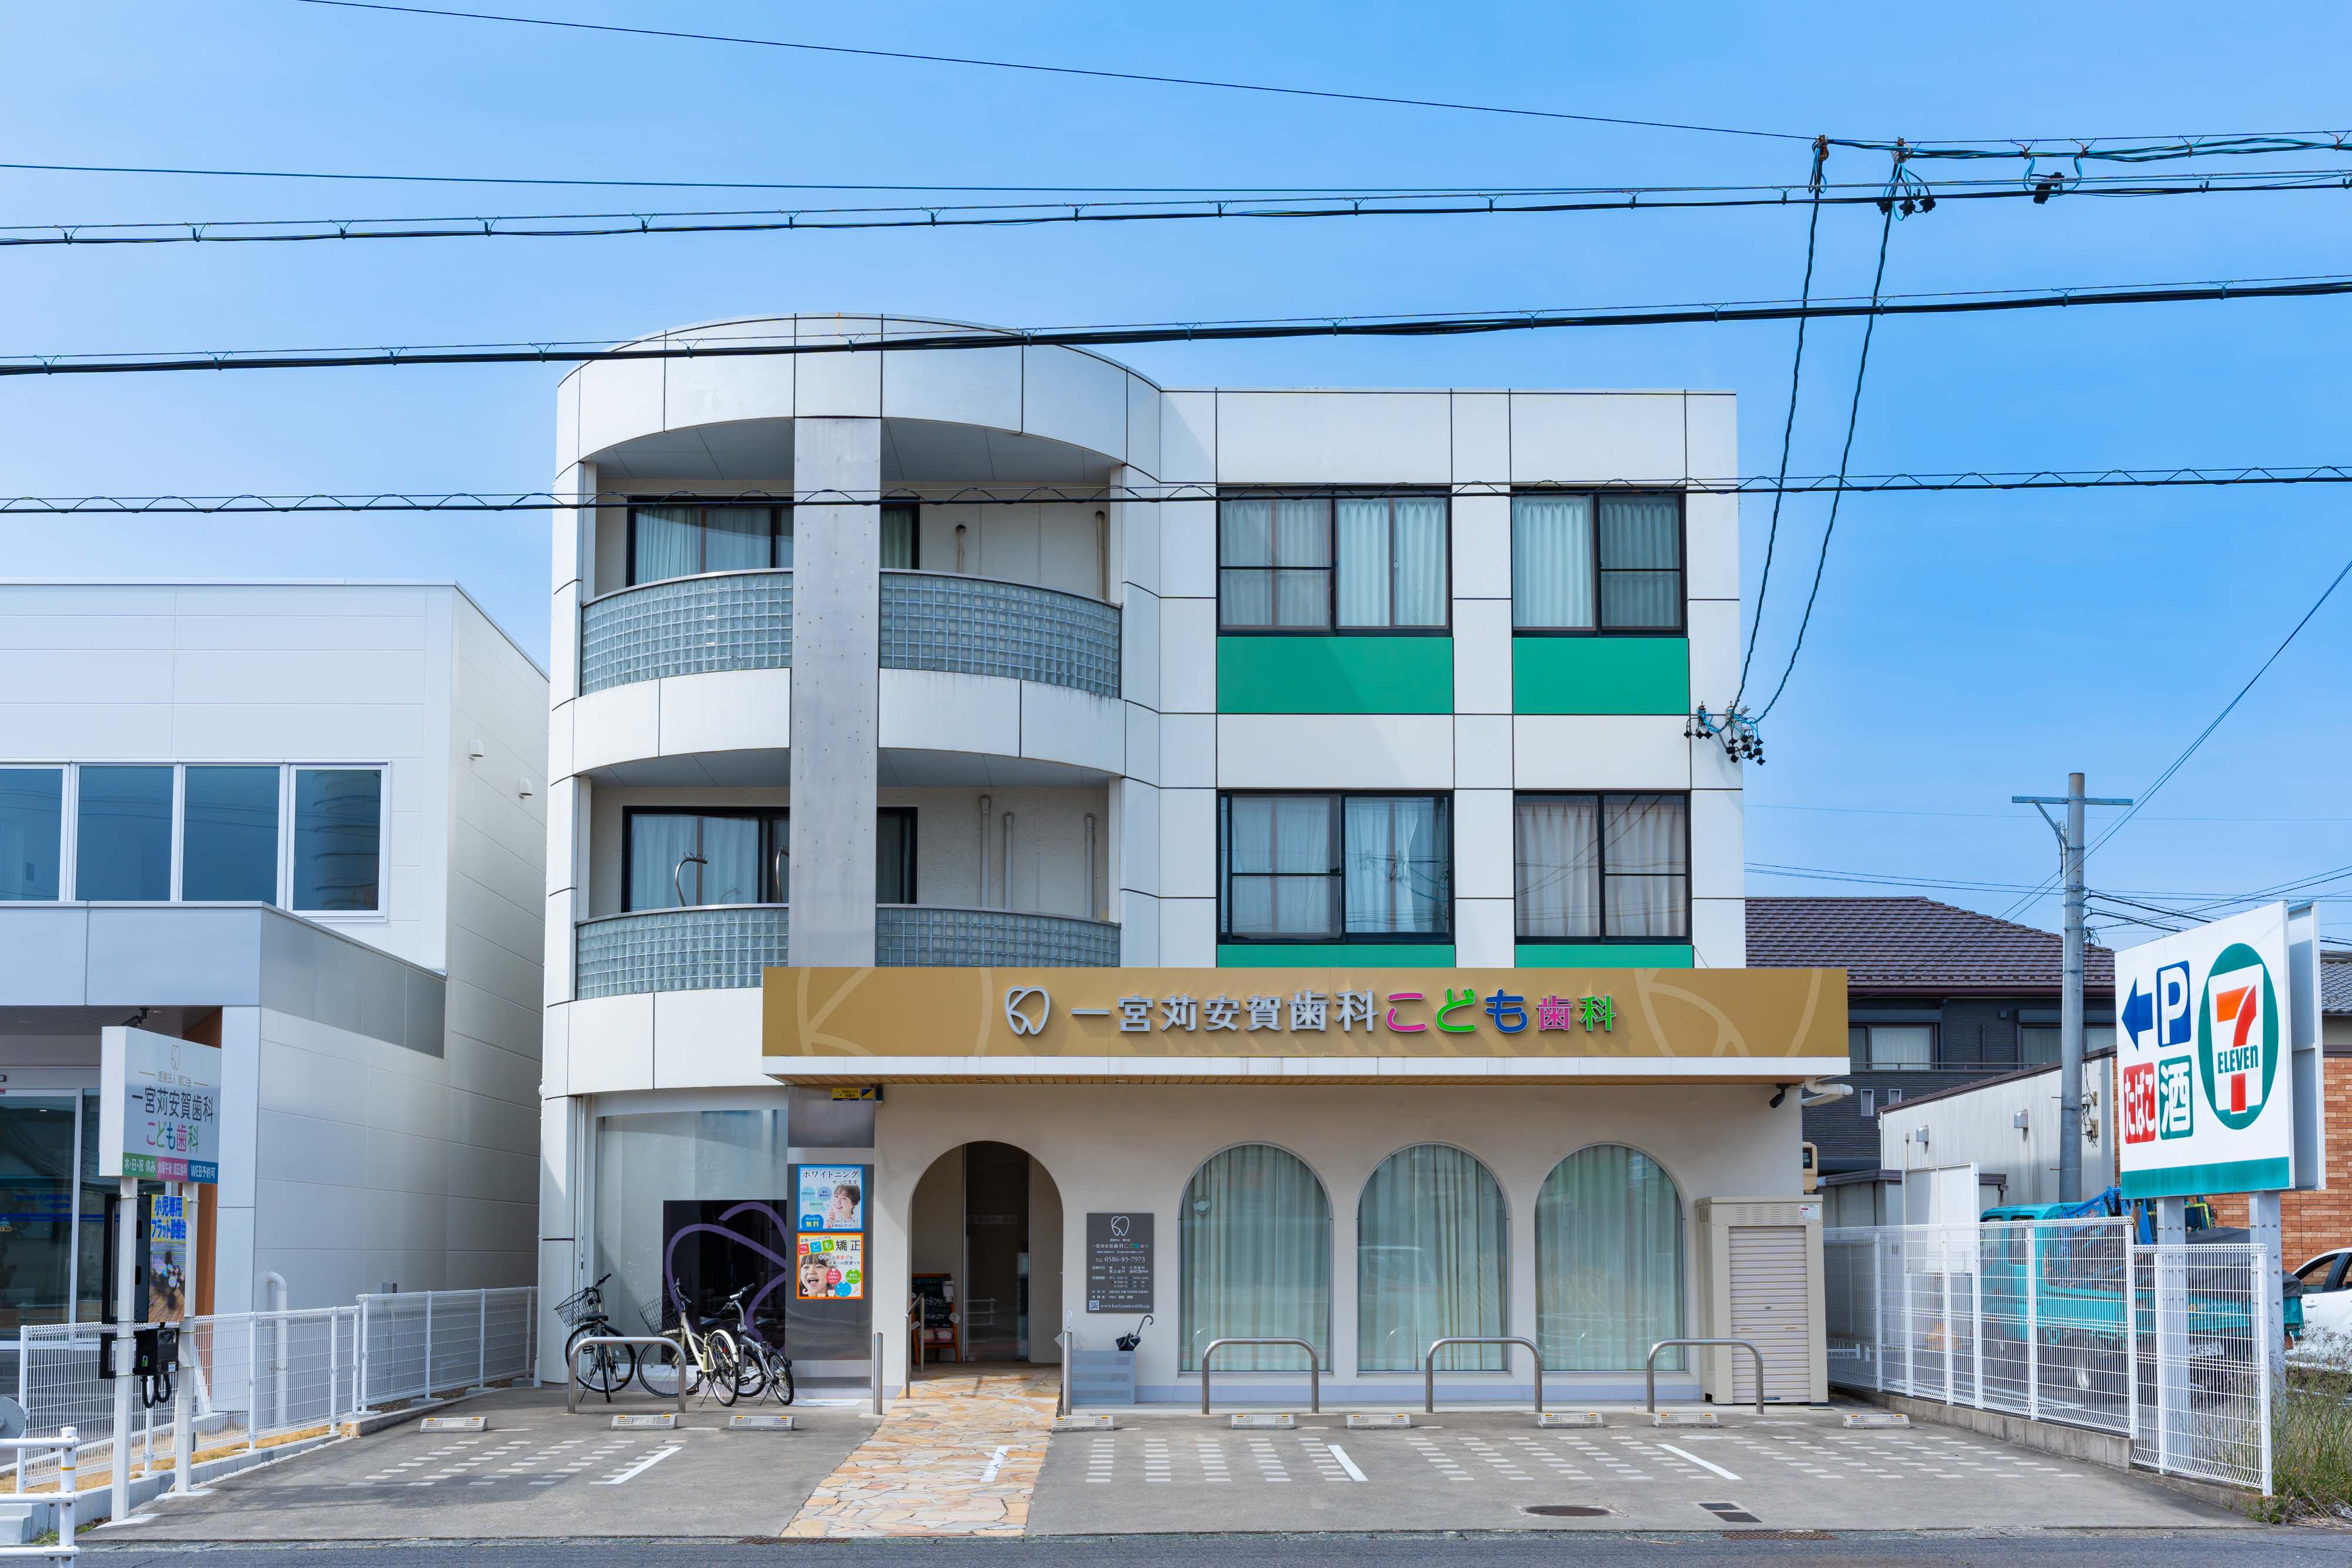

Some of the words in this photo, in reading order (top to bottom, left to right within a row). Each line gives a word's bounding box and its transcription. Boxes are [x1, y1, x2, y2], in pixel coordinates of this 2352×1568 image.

[2160, 965, 2189, 1045] P
[2216, 984, 2257, 1115] 7
[132, 1085, 213, 1124] 一宮苅安賀歯科
[2124, 1067, 2156, 1137] たばこ
[2160, 1061, 2190, 1134] 酒
[147, 1120, 198, 1154] こども歯科
[191, 1165, 216, 1179] WEB予約可
[803, 1170, 859, 1179] ホワイトニング
